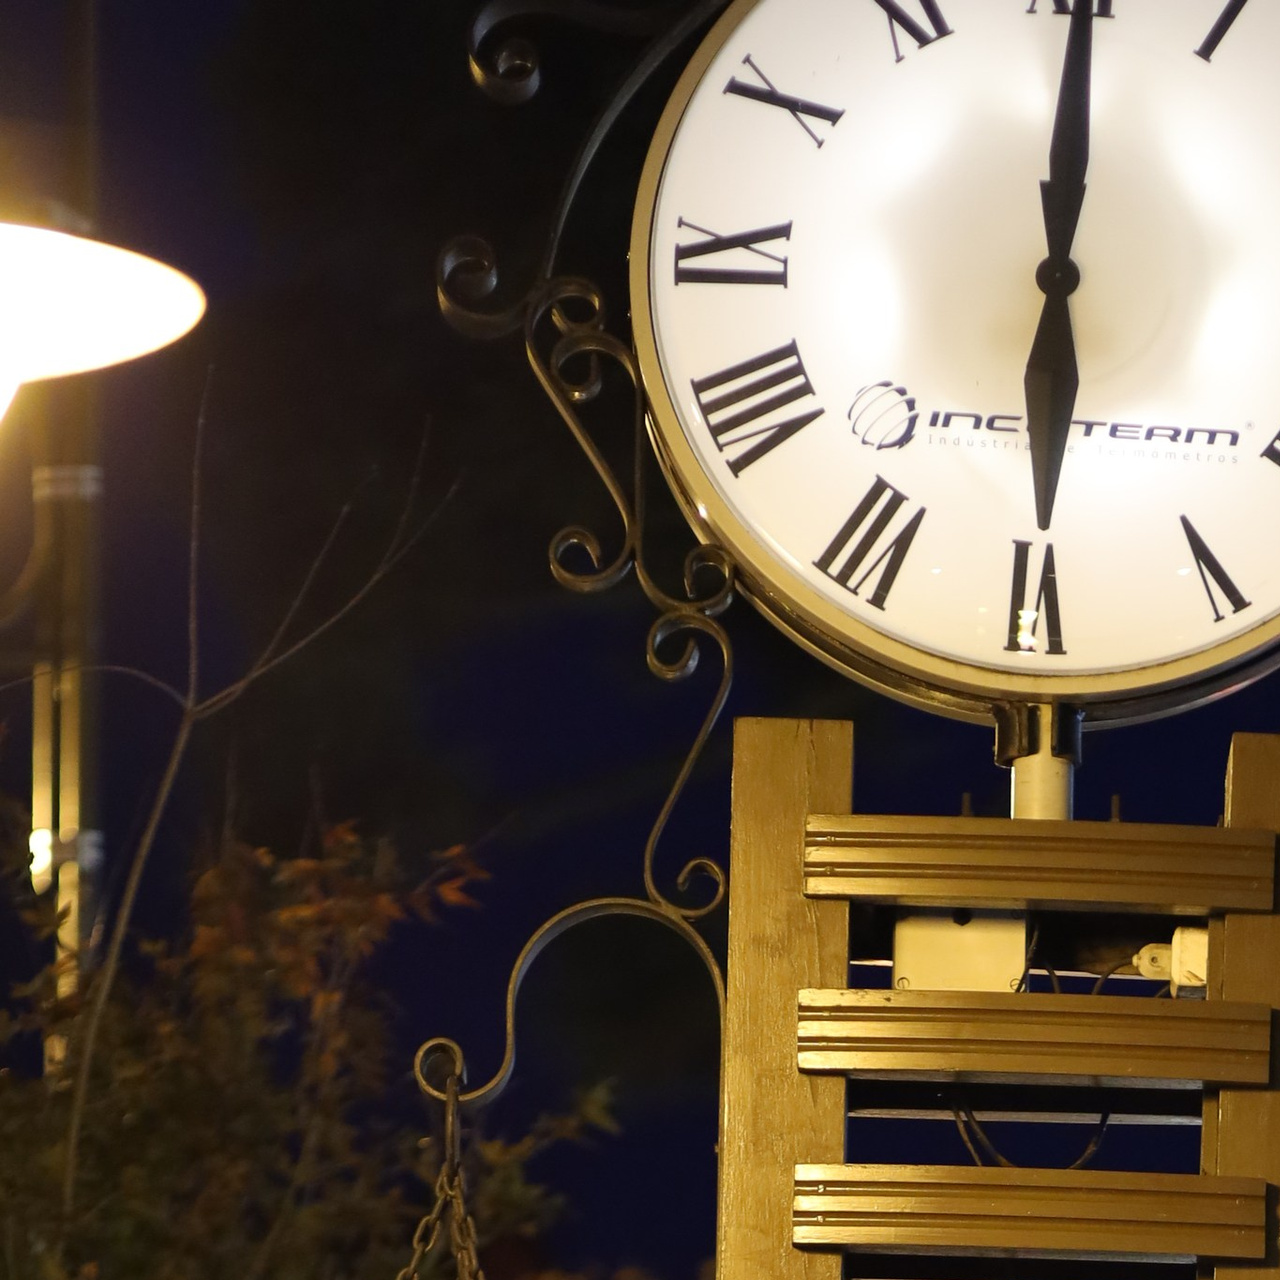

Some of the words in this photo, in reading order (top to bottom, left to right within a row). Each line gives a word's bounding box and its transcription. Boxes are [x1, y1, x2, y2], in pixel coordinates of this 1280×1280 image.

[722, 53, 846, 149] X
[674, 216, 793, 289] IX
[690, 338, 825, 479] VIII
[929, 411, 1240, 447] INCTERM
[812, 474, 927, 611] VII
[1179, 514, 1252, 622] V
[1003, 539, 1067, 655] VI
